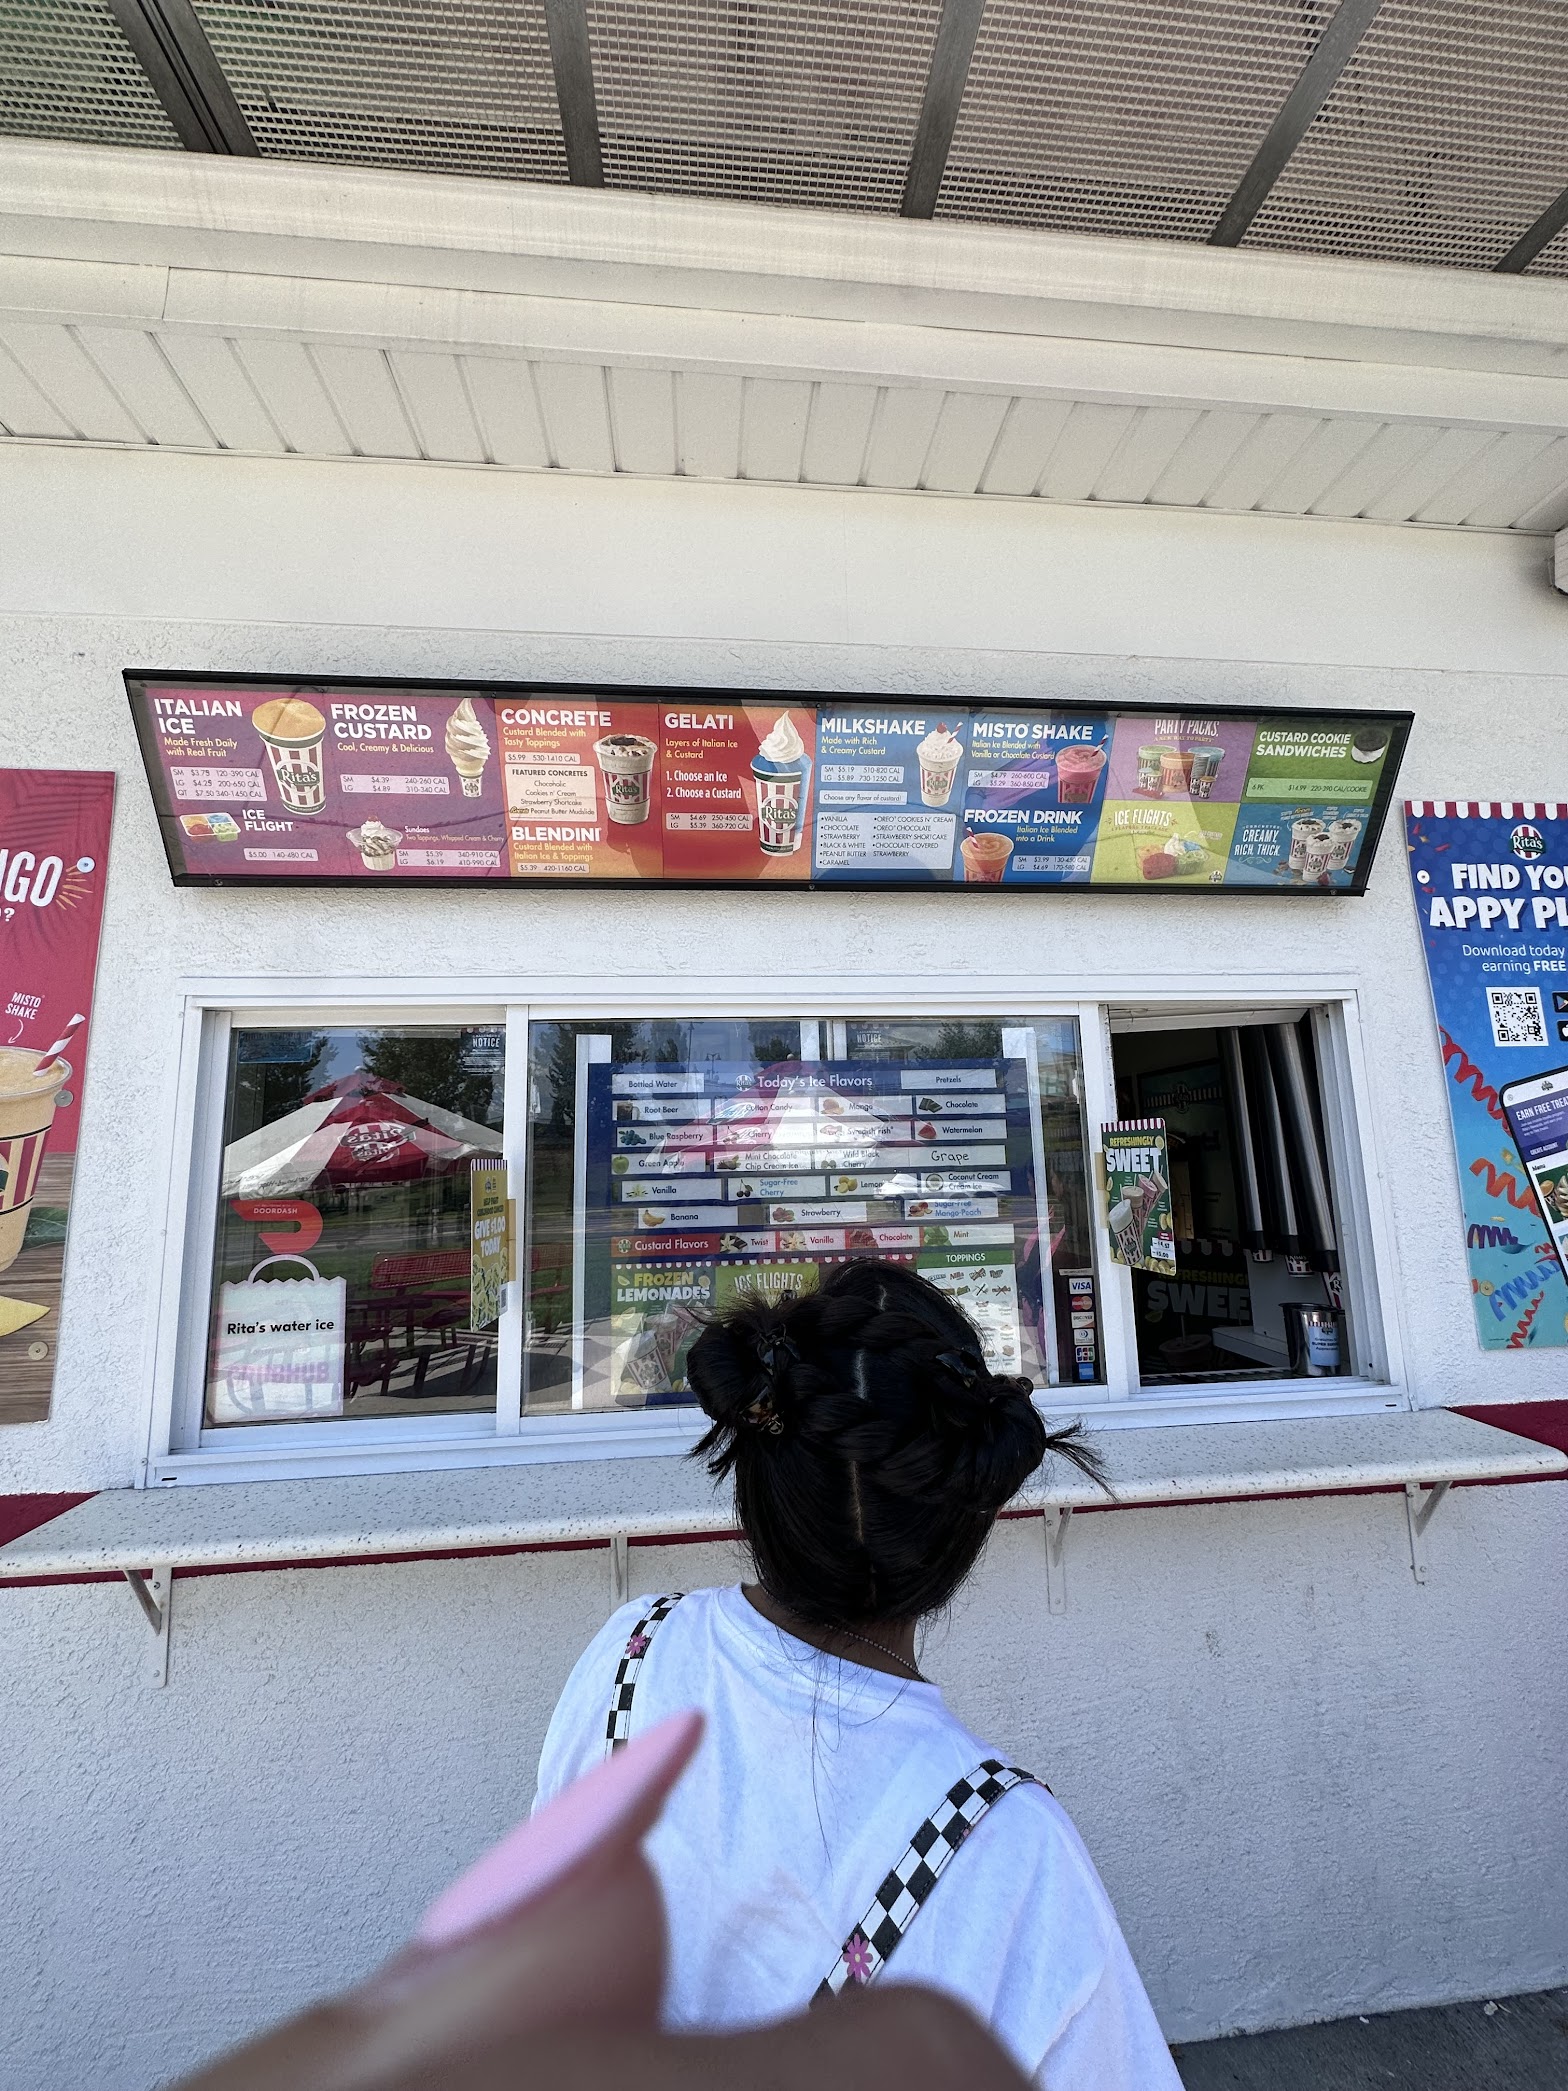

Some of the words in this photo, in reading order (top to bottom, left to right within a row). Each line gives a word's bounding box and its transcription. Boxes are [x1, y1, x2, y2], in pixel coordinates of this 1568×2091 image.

[154, 698, 242, 717] ITALIAN
[330, 703, 418, 722] FROZEN
[501, 708, 612, 727] CONCRETE
[664, 712, 734, 730] GELATI
[158, 718, 196, 734] ICE
[334, 722, 432, 740] CUSTARD
[503, 727, 533, 736] Custard
[536, 728, 567, 737] Blended
[569, 729, 586, 737] with
[821, 718, 926, 735] MILKSHAKE
[1032, 724, 1093, 740] SHAKE
[1154, 719, 1188, 735] PARTY
[164, 737, 189, 746] Made
[190, 738, 214, 747] Fresh
[215, 739, 238, 749] Daily
[504, 738, 524, 747] Tasty
[525, 738, 560, 748] Toppings
[666, 738, 689, 748] Layers
[692, 739, 700, 747] of
[702, 740, 725, 748] Italian
[821, 736, 842, 744] Made
[845, 737, 860, 745] with
[862, 737, 877, 745] Rich
[1259, 731, 1308, 743] CUSTARD
[1310, 733, 1351, 744] COOKIE
[166, 747, 185, 756] with
[187, 747, 206, 756] Real
[208, 748, 227, 757] Fruit
[338, 742, 357, 752] Cool,
[360, 743, 389, 754] Creamy
[392, 744, 399, 752] &
[400, 744, 434, 753] Delicious
[821, 746, 827, 754] &
[829, 746, 856, 756] Creamy
[858, 747, 886, 755] Custard
[1256, 744, 1347, 758] SANDWICHES
[245, 770, 260, 778] CAL
[280, 769, 317, 783] Rita's
[512, 768, 546, 776] FEATURED
[666, 770, 672, 781] 1.
[674, 770, 702, 782] Choose
[704, 773, 714, 781] an
[716, 771, 727, 782] Ice
[667, 787, 673, 797] 2.
[675, 787, 704, 798] Choose
[706, 790, 710, 798] a
[712, 788, 742, 799] Custard
[857, 794, 872, 802] flavor
[242, 809, 265, 820] ICE
[765, 806, 796, 820] Rita's
[964, 809, 1030, 824] FROZEN
[1033, 810, 1083, 825] DRINK
[1114, 810, 1131, 826] ICE
[1132, 809, 1172, 827] FLIGHTS
[244, 821, 293, 832] FLIGHT
[1051, 826, 1078, 834] Blended
[512, 826, 600, 842] BLENDINI
[1037, 835, 1055, 843] Drink
[513, 842, 542, 850] Custard
[544, 843, 575, 851] Blended
[1512, 835, 1543, 850] Rita's
[0, 848, 63, 907] GO
[1451, 863, 1521, 890] FIND
[1429, 896, 1526, 929] APPY
[1531, 896, 1568, 929] PL
[1462, 944, 1527, 956] Download
[1529, 945, 1565, 958] today
[1482, 960, 1531, 974] earning
[1534, 960, 1567, 972] FREE
[12, 992, 42, 1008] MISTO
[5, 1003, 38, 1020] SHAKE
[473, 1038, 500, 1047] NOTICE
[629, 1080, 653, 1088] Bottled
[655, 1080, 677, 1088] Water
[758, 1076, 805, 1090] Today's
[809, 1075, 825, 1086] Ice
[830, 1074, 873, 1086] Flavors
[644, 1106, 660, 1114] Root
[1516, 1107, 1534, 1121] EARN
[1535, 1102, 1552, 1115] FREE
[649, 1132, 664, 1140] Blue
[666, 1132, 703, 1142] Raspberry
[942, 1126, 982, 1134] Watermelon
[1109, 1136, 1155, 1148] REFRESHINGLY
[930, 1150, 970, 1164] Grape
[1106, 1148, 1162, 1172] SWEET
[948, 1173, 975, 1181] Coconut
[652, 1186, 677, 1194] Vanilla
[801, 1208, 841, 1217] Strawberry
[935, 1209, 982, 1217] Mango-Peach
[474, 1219, 490, 1240] GIVE
[481, 1236, 501, 1258] TODAY
[634, 1240, 672, 1250] Custard
[674, 1239, 708, 1249] Flavors
[810, 1236, 834, 1244] Vanilla
[946, 1253, 986, 1263] TOPPINGS
[634, 1271, 694, 1287] FROZEN
[756, 1272, 803, 1290] FLIGHTS
[1072, 1282, 1091, 1290] VISA
[616, 1286, 710, 1302] LEMONADES
[1147, 1280, 1250, 1320] SWEE
[227, 1321, 266, 1334] Rita's
[270, 1321, 311, 1332] water
[315, 1319, 334, 1330] ice
